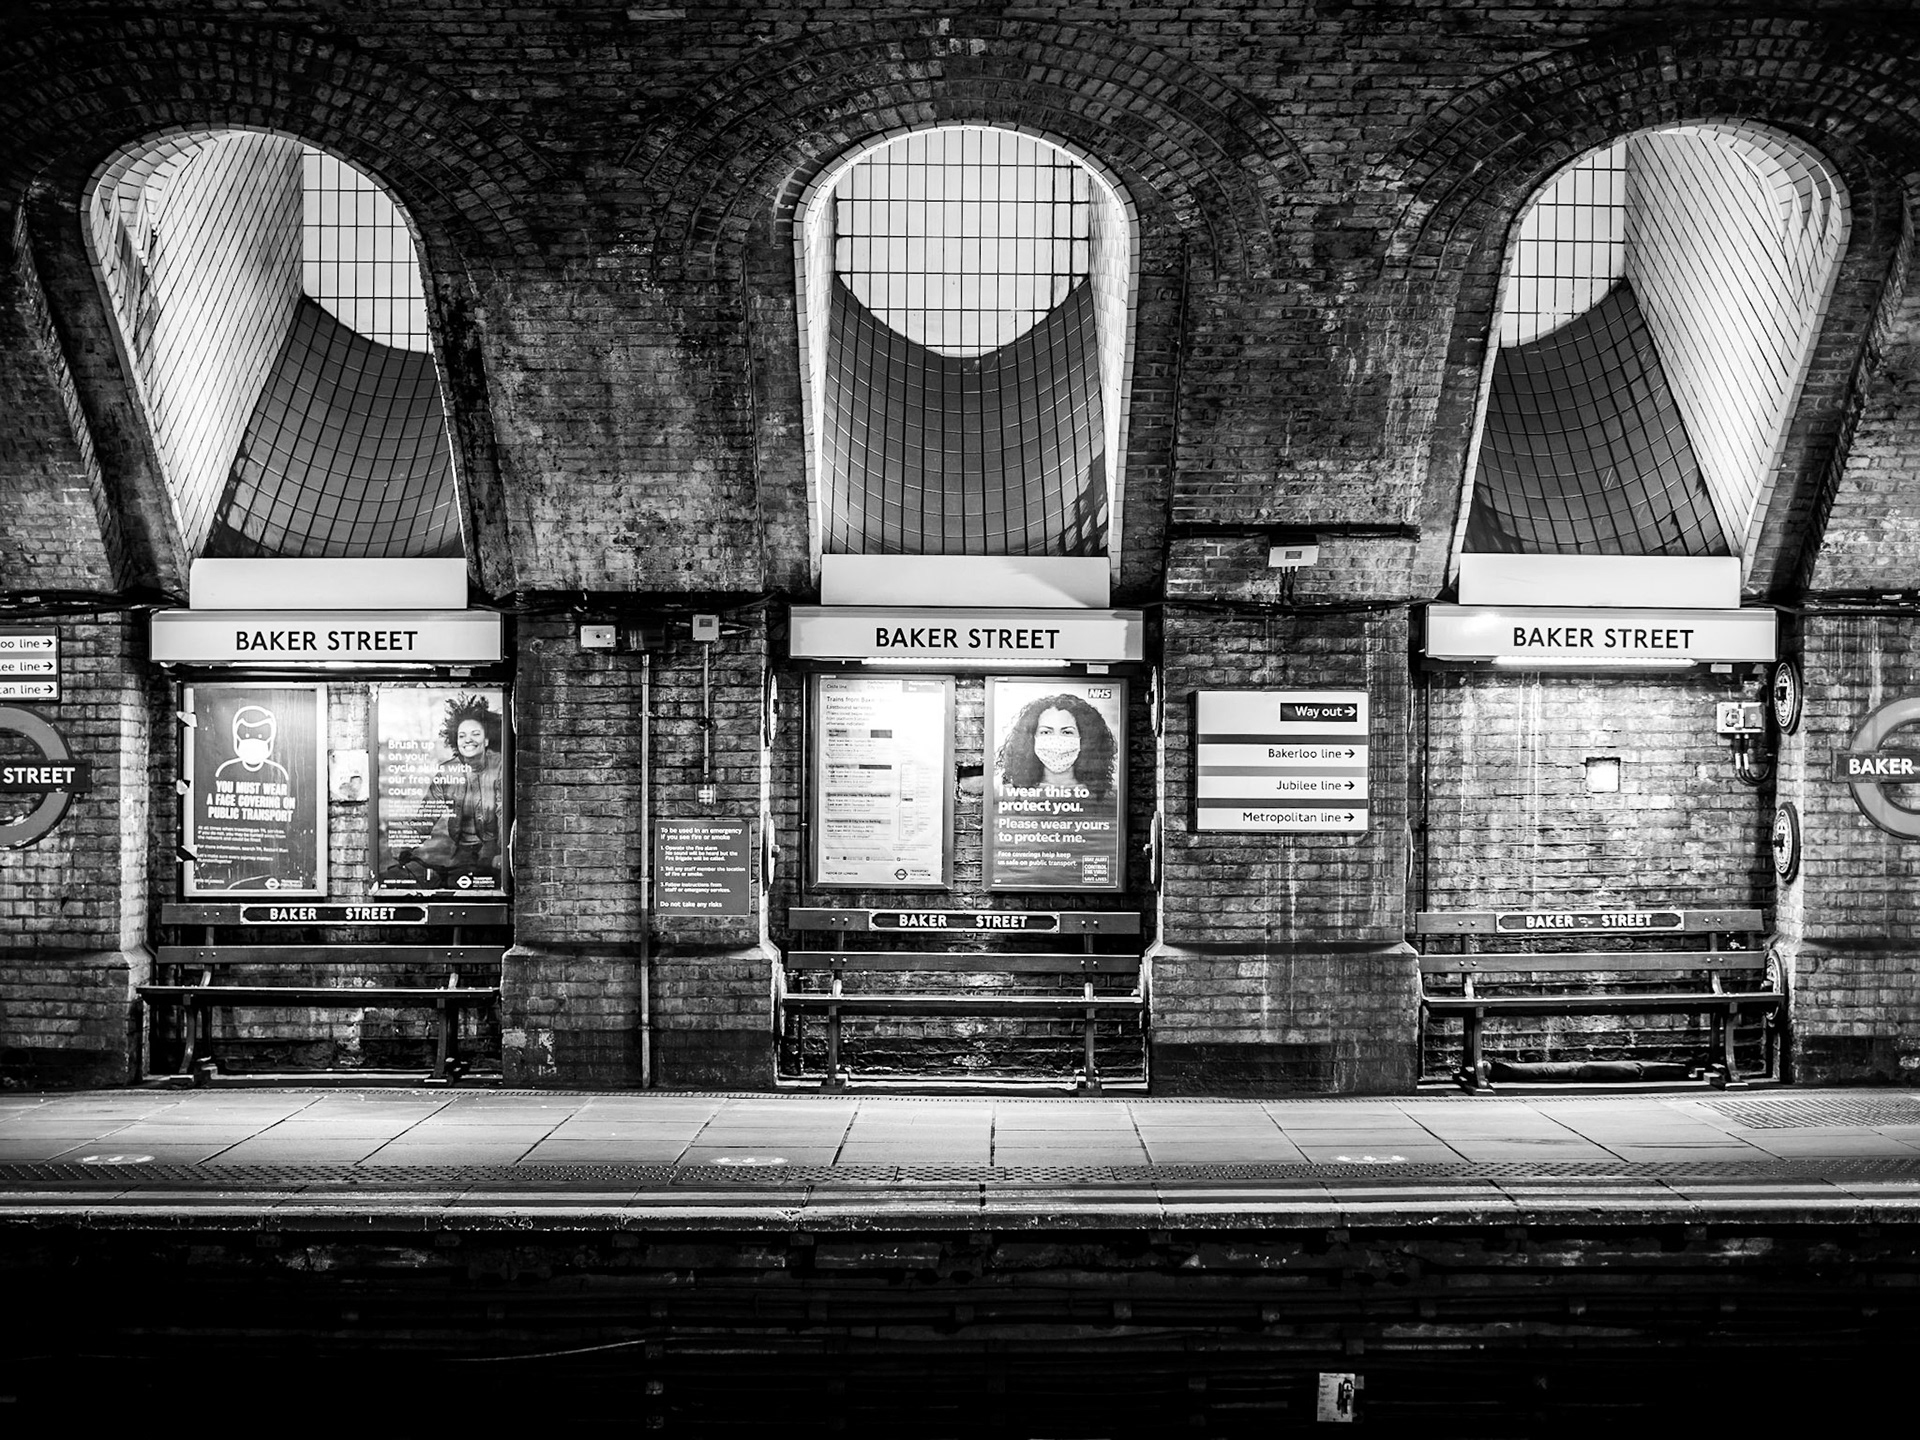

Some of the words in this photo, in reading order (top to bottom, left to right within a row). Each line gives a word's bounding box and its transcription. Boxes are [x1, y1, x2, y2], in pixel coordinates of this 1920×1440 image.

[19, 638, 40, 648] line
[236, 631, 318, 651] BAKER
[327, 631, 418, 651] STREET
[876, 628, 959, 648] BAKER
[968, 628, 1060, 649] STREET
[1513, 627, 1594, 647] BAKER
[1604, 629, 1694, 649] STREET
[20, 661, 41, 671] line
[20, 685, 41, 694] line
[1089, 689, 1111, 698] NHS
[1295, 705, 1320, 718] Way
[1322, 706, 1342, 717] out
[388, 740, 418, 749] Brush
[421, 741, 434, 751] up
[404, 753, 429, 762] your
[1268, 748, 1317, 759] Bakerloo
[1321, 749, 1342, 759] line
[388, 764, 416, 773] cycle
[417, 764, 445, 773] skills
[448, 764, 472, 773] with
[1849, 758, 1914, 775] BAKER
[3, 767, 76, 784] STREET
[388, 776, 406, 784] our
[408, 775, 431, 784] free
[433, 775, 466, 784] online
[216, 781, 234, 793] YOU
[236, 782, 261, 795] MUST
[263, 783, 288, 796] WEAR
[388, 787, 423, 796] course
[999, 787, 1004, 797] I
[1006, 788, 1042, 798] wear
[1044, 786, 1071, 798] this
[1074, 787, 1090, 798] to
[1276, 780, 1317, 791] Jubilee
[1321, 781, 1342, 791] line
[206, 793, 213, 806] A
[215, 794, 236, 806] FACE
[238, 794, 280, 809] COVERING
[283, 797, 296, 810] ON
[998, 800, 1051, 814] protect
[1053, 802, 1084, 815] you.
[208, 806, 240, 819] PUBLIC
[241, 808, 293, 822] TRANSPORT
[1242, 812, 1317, 823] Metropolitan
[1321, 812, 1342, 822] line
[998, 818, 1038, 829] Please
[1040, 821, 1073, 830] wear
[1075, 821, 1110, 832] yours
[998, 831, 1012, 842] to
[1014, 832, 1060, 844] protect
[1063, 834, 1086, 843] me.
[269, 908, 317, 921] BAKER
[345, 908, 396, 920] STREET
[899, 914, 947, 927] BAKER
[975, 915, 1027, 928] STREET
[1526, 915, 1574, 928] BAKER
[1601, 914, 1652, 928] STREET
